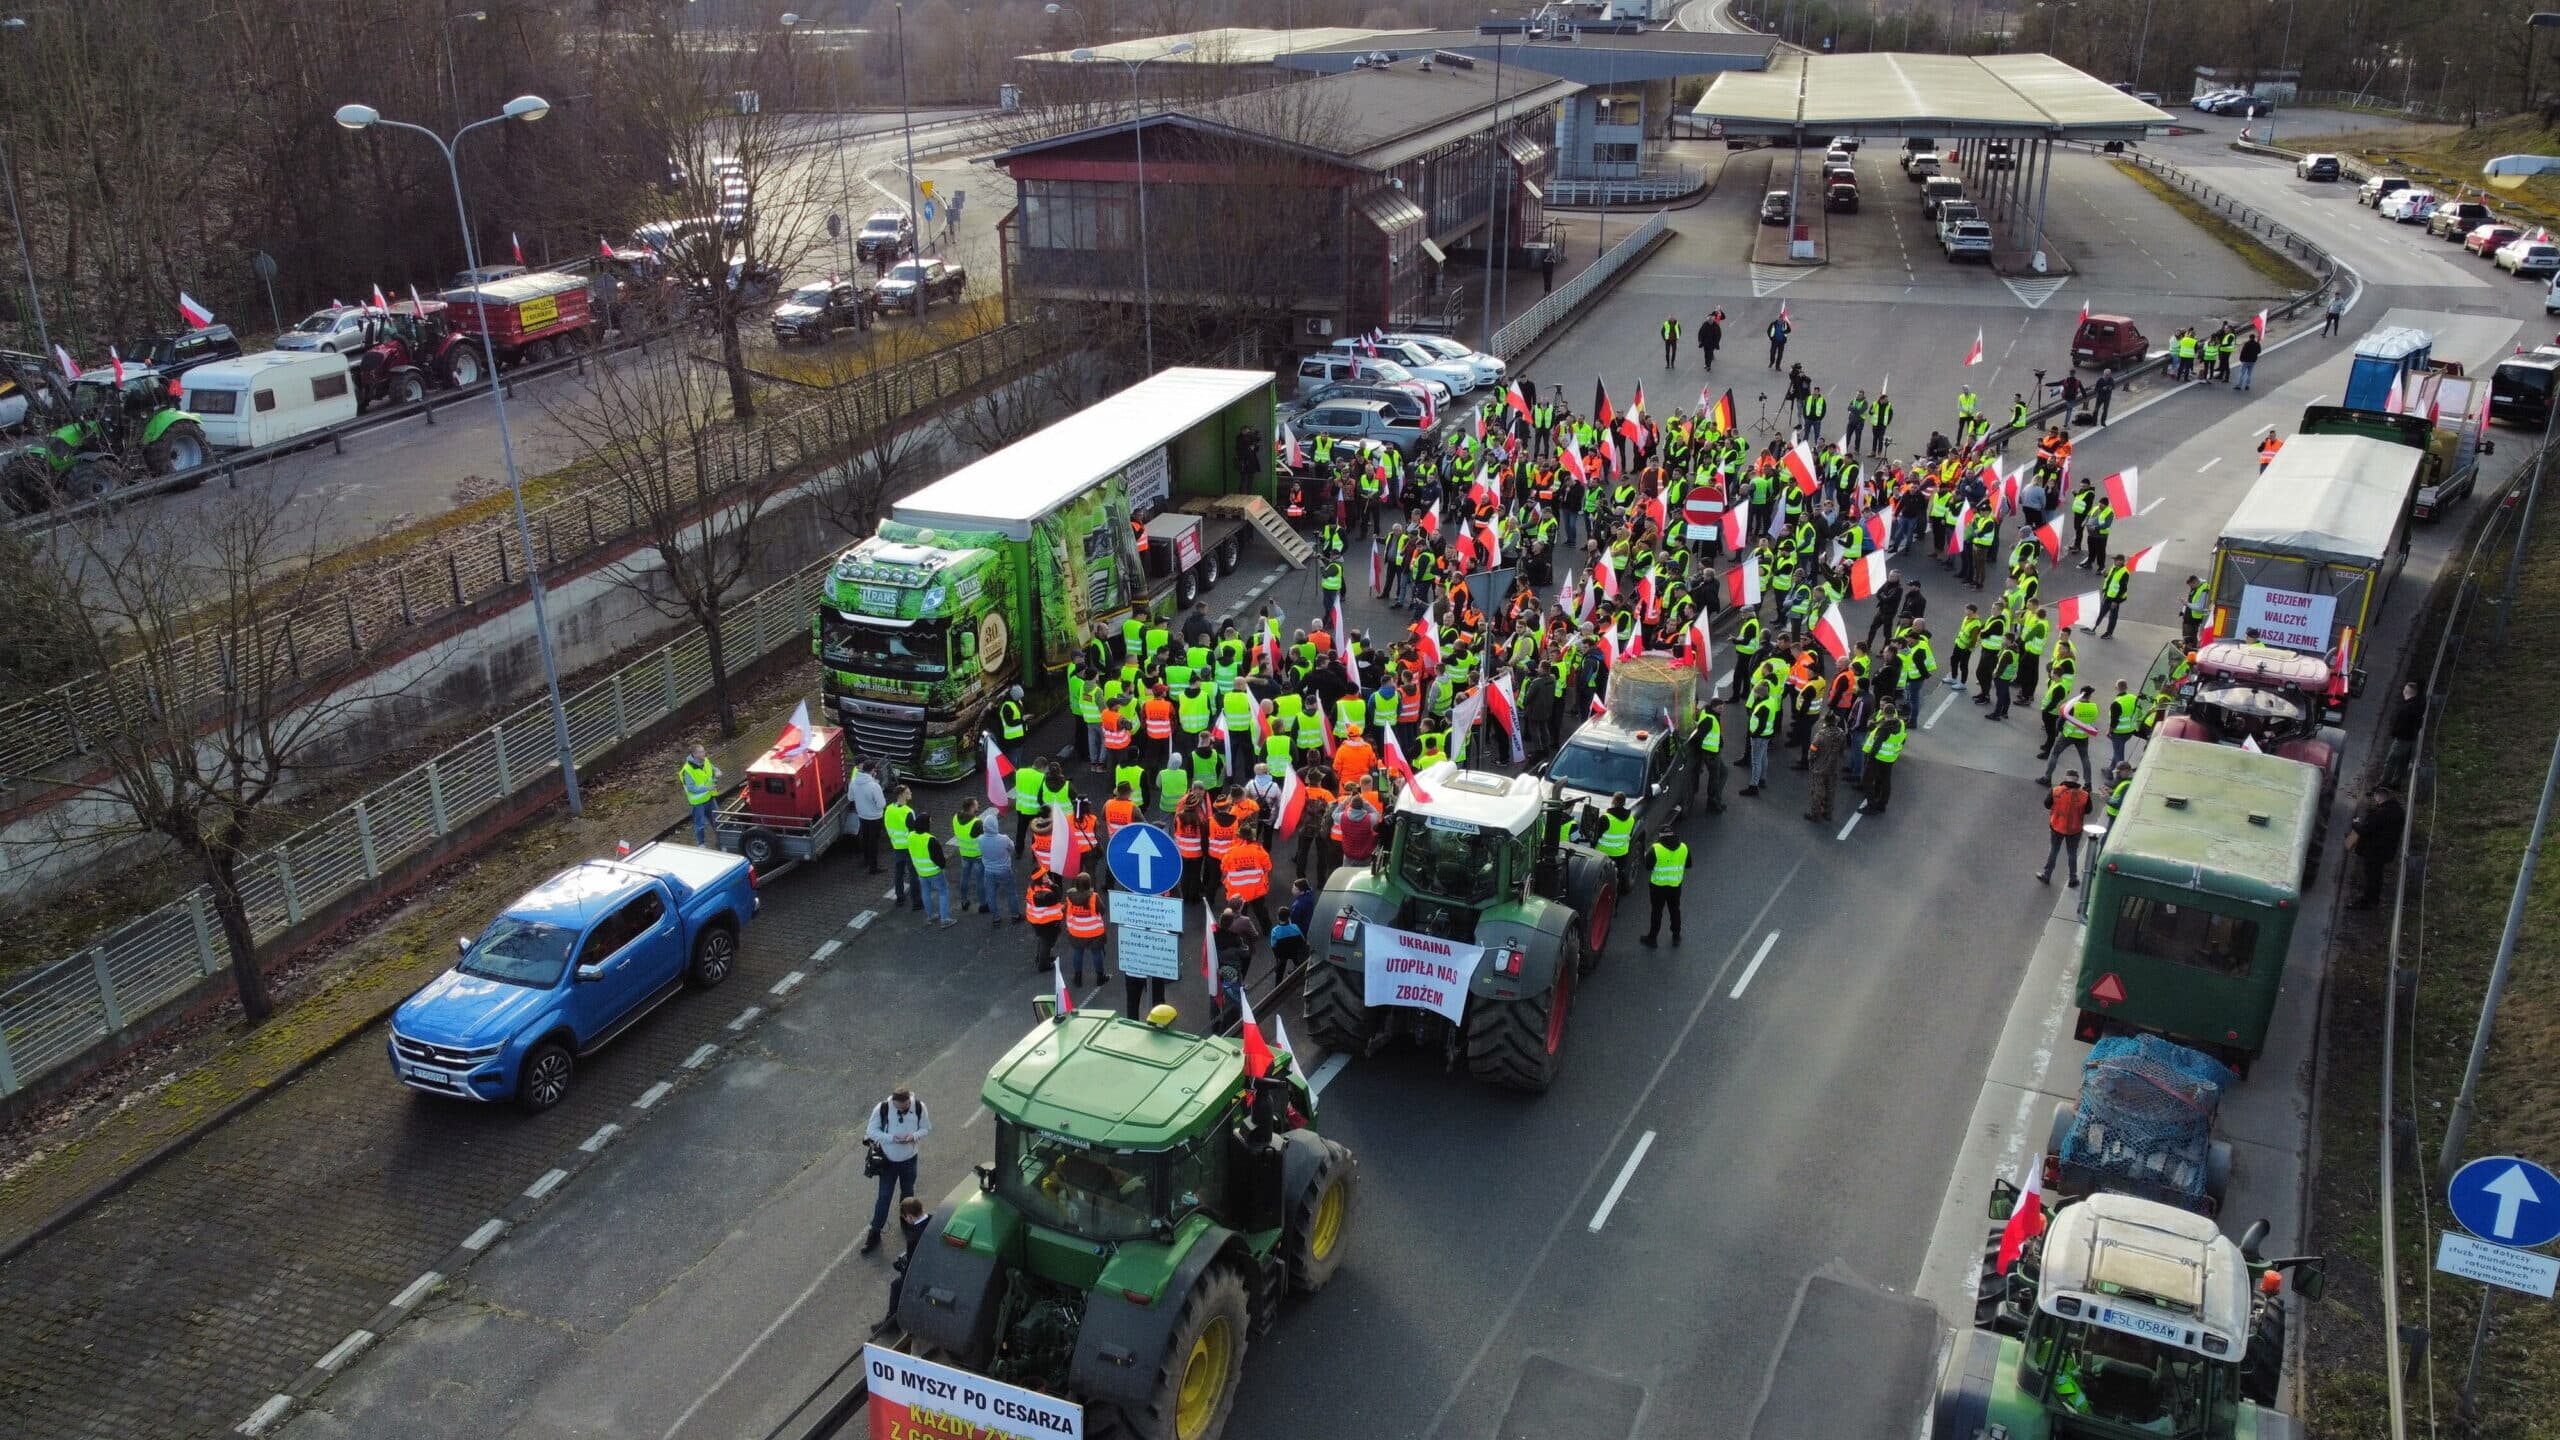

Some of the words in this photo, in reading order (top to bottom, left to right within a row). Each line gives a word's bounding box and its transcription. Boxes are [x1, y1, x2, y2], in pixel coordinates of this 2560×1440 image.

[2266, 592, 2313, 609] BĘDZIEMY
[2264, 610, 2307, 628] WALCZYĆ
[2286, 632, 2320, 649] ZIEMIĘ
[1399, 935, 1452, 956] UKRAINA
[1386, 957, 1434, 977] UTOPIŁA
[1437, 964, 1458, 985] NAS
[1395, 984, 1444, 1007] ZBOŻEM
[2472, 1242, 2489, 1252] Nie
[2493, 1248, 2532, 1263] dotyczy
[2458, 1266, 2539, 1292] utrzymaniowych
[2465, 1259, 2529, 1280] ratunkowych
[2110, 1311, 2133, 1327] FSL
[2137, 1319, 2177, 1338] 058AW
[873, 1361, 894, 1381] OD
[901, 1370, 957, 1401] MYSZY
[964, 1388, 987, 1410] PO
[994, 1398, 1074, 1435] CESARZA
[909, 1402, 976, 1438] KAŻDY
